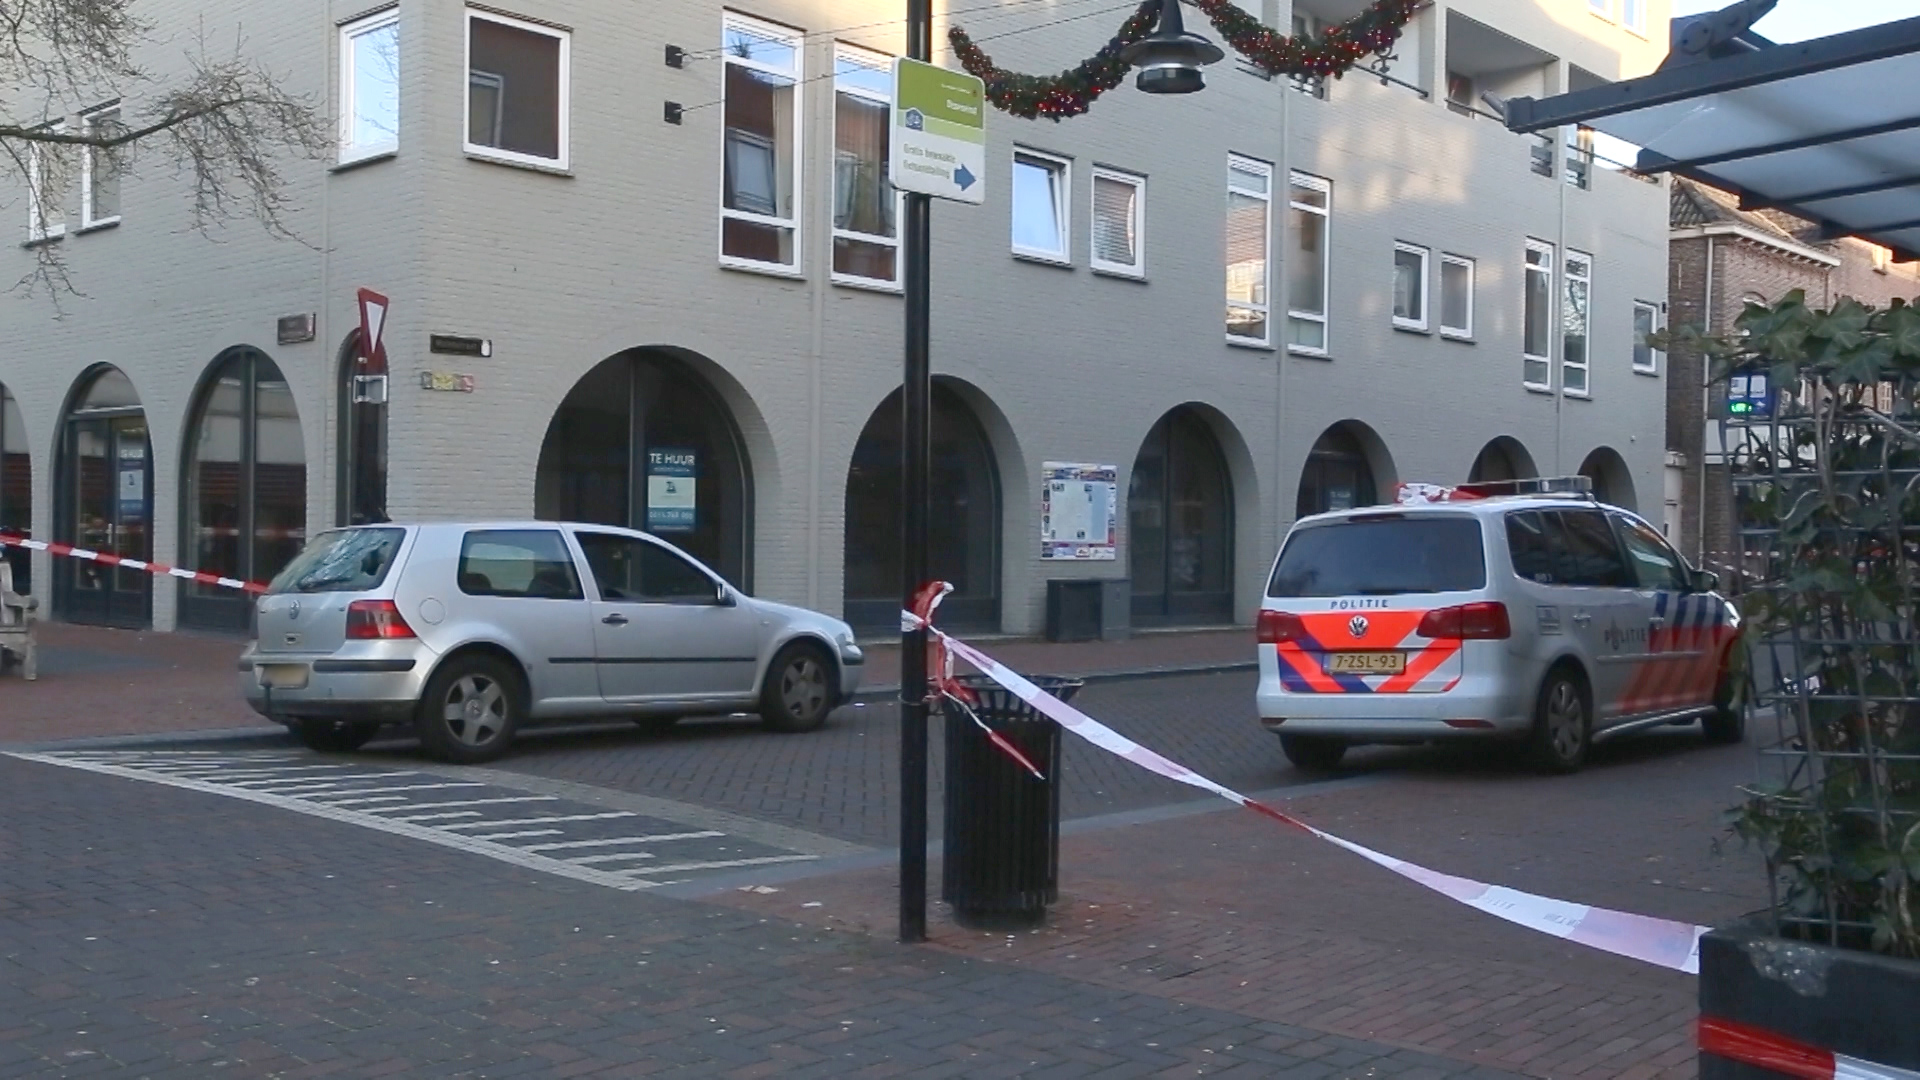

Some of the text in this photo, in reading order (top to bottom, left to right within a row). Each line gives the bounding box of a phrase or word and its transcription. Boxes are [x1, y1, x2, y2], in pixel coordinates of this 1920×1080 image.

[649, 452, 696, 466] TE HUUR
[1330, 598, 1389, 610] POLITIE
[1603, 626, 1647, 645] PLITIE
[1336, 654, 1398, 669] 7-ZSL-93
